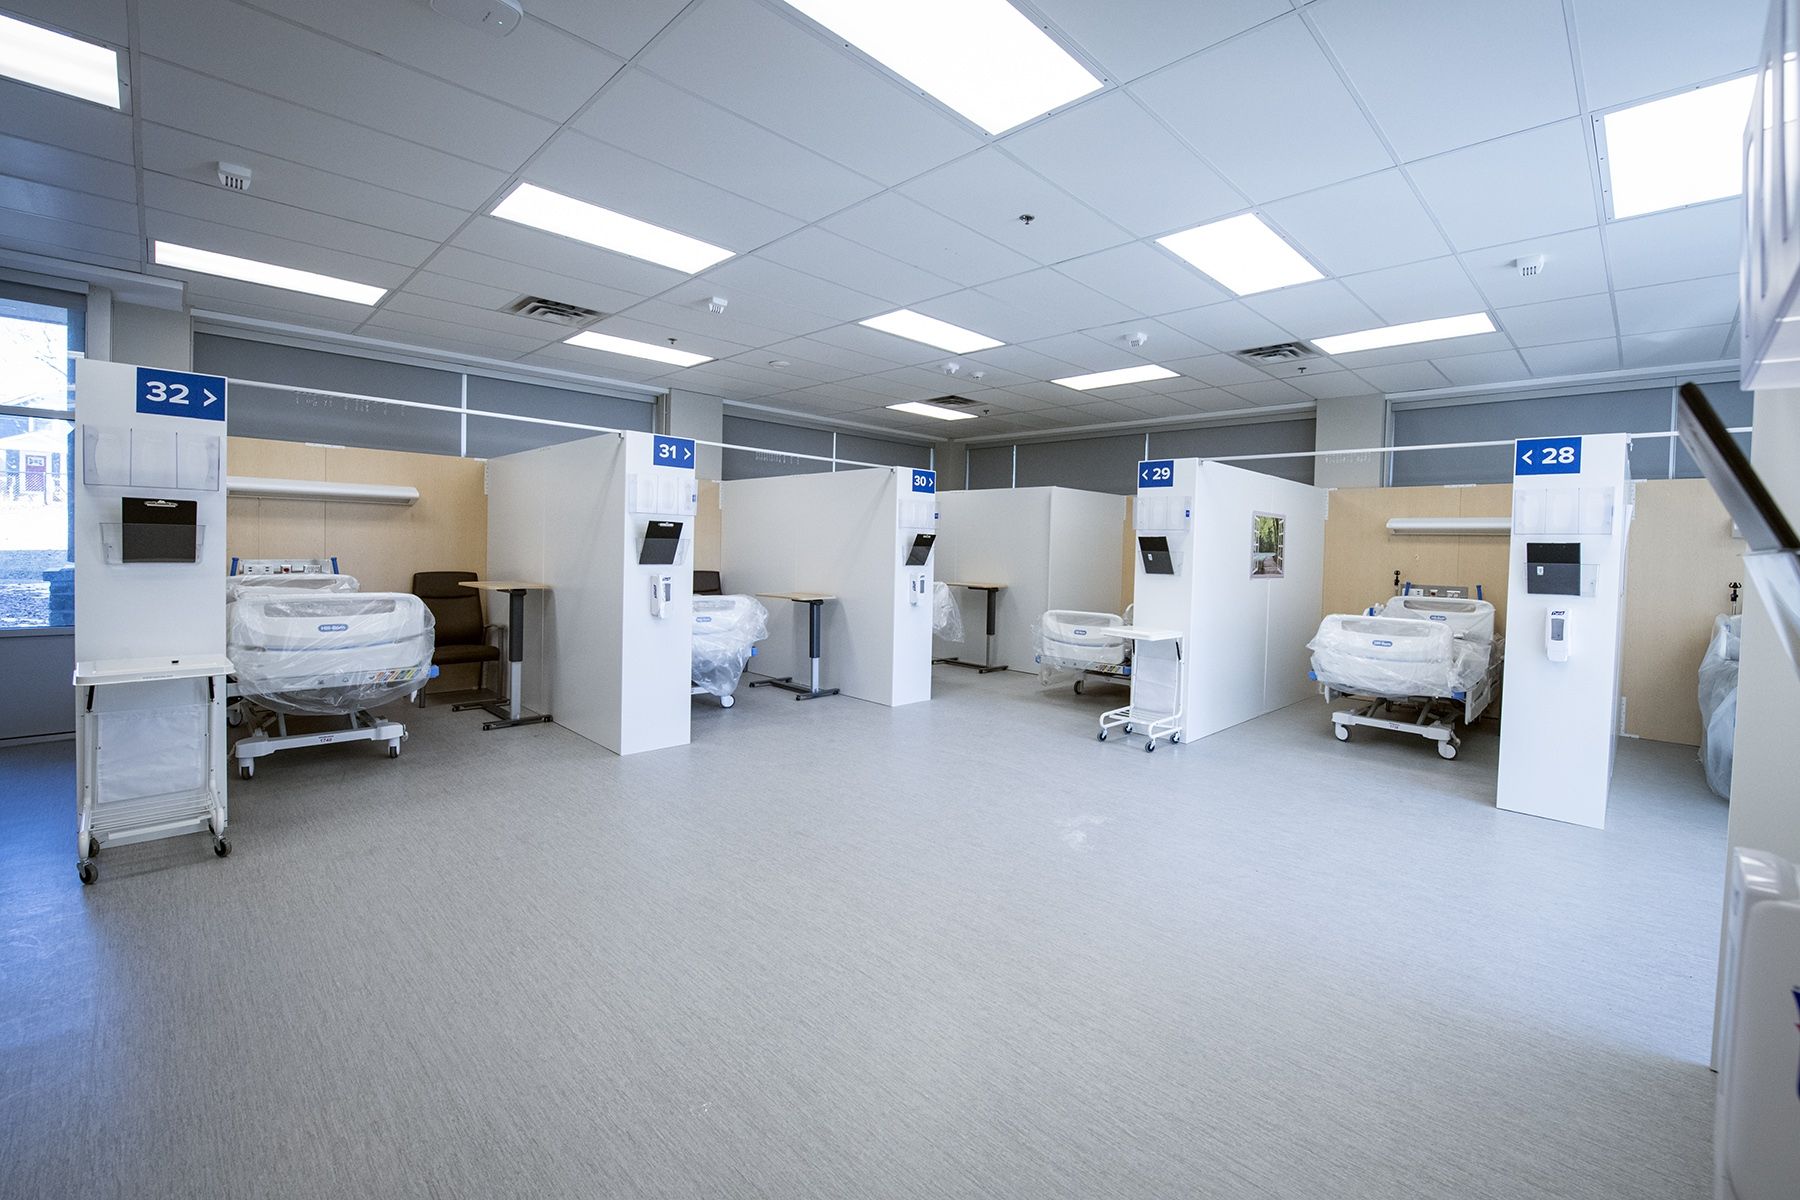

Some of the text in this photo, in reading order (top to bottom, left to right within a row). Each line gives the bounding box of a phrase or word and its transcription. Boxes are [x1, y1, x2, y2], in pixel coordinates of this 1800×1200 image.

[145, 381, 190, 405] 32
[659, 444, 677, 459] 31
[1541, 446, 1575, 465] 28
[914, 475, 926, 487] 30
[1152, 467, 1171, 480] 29
